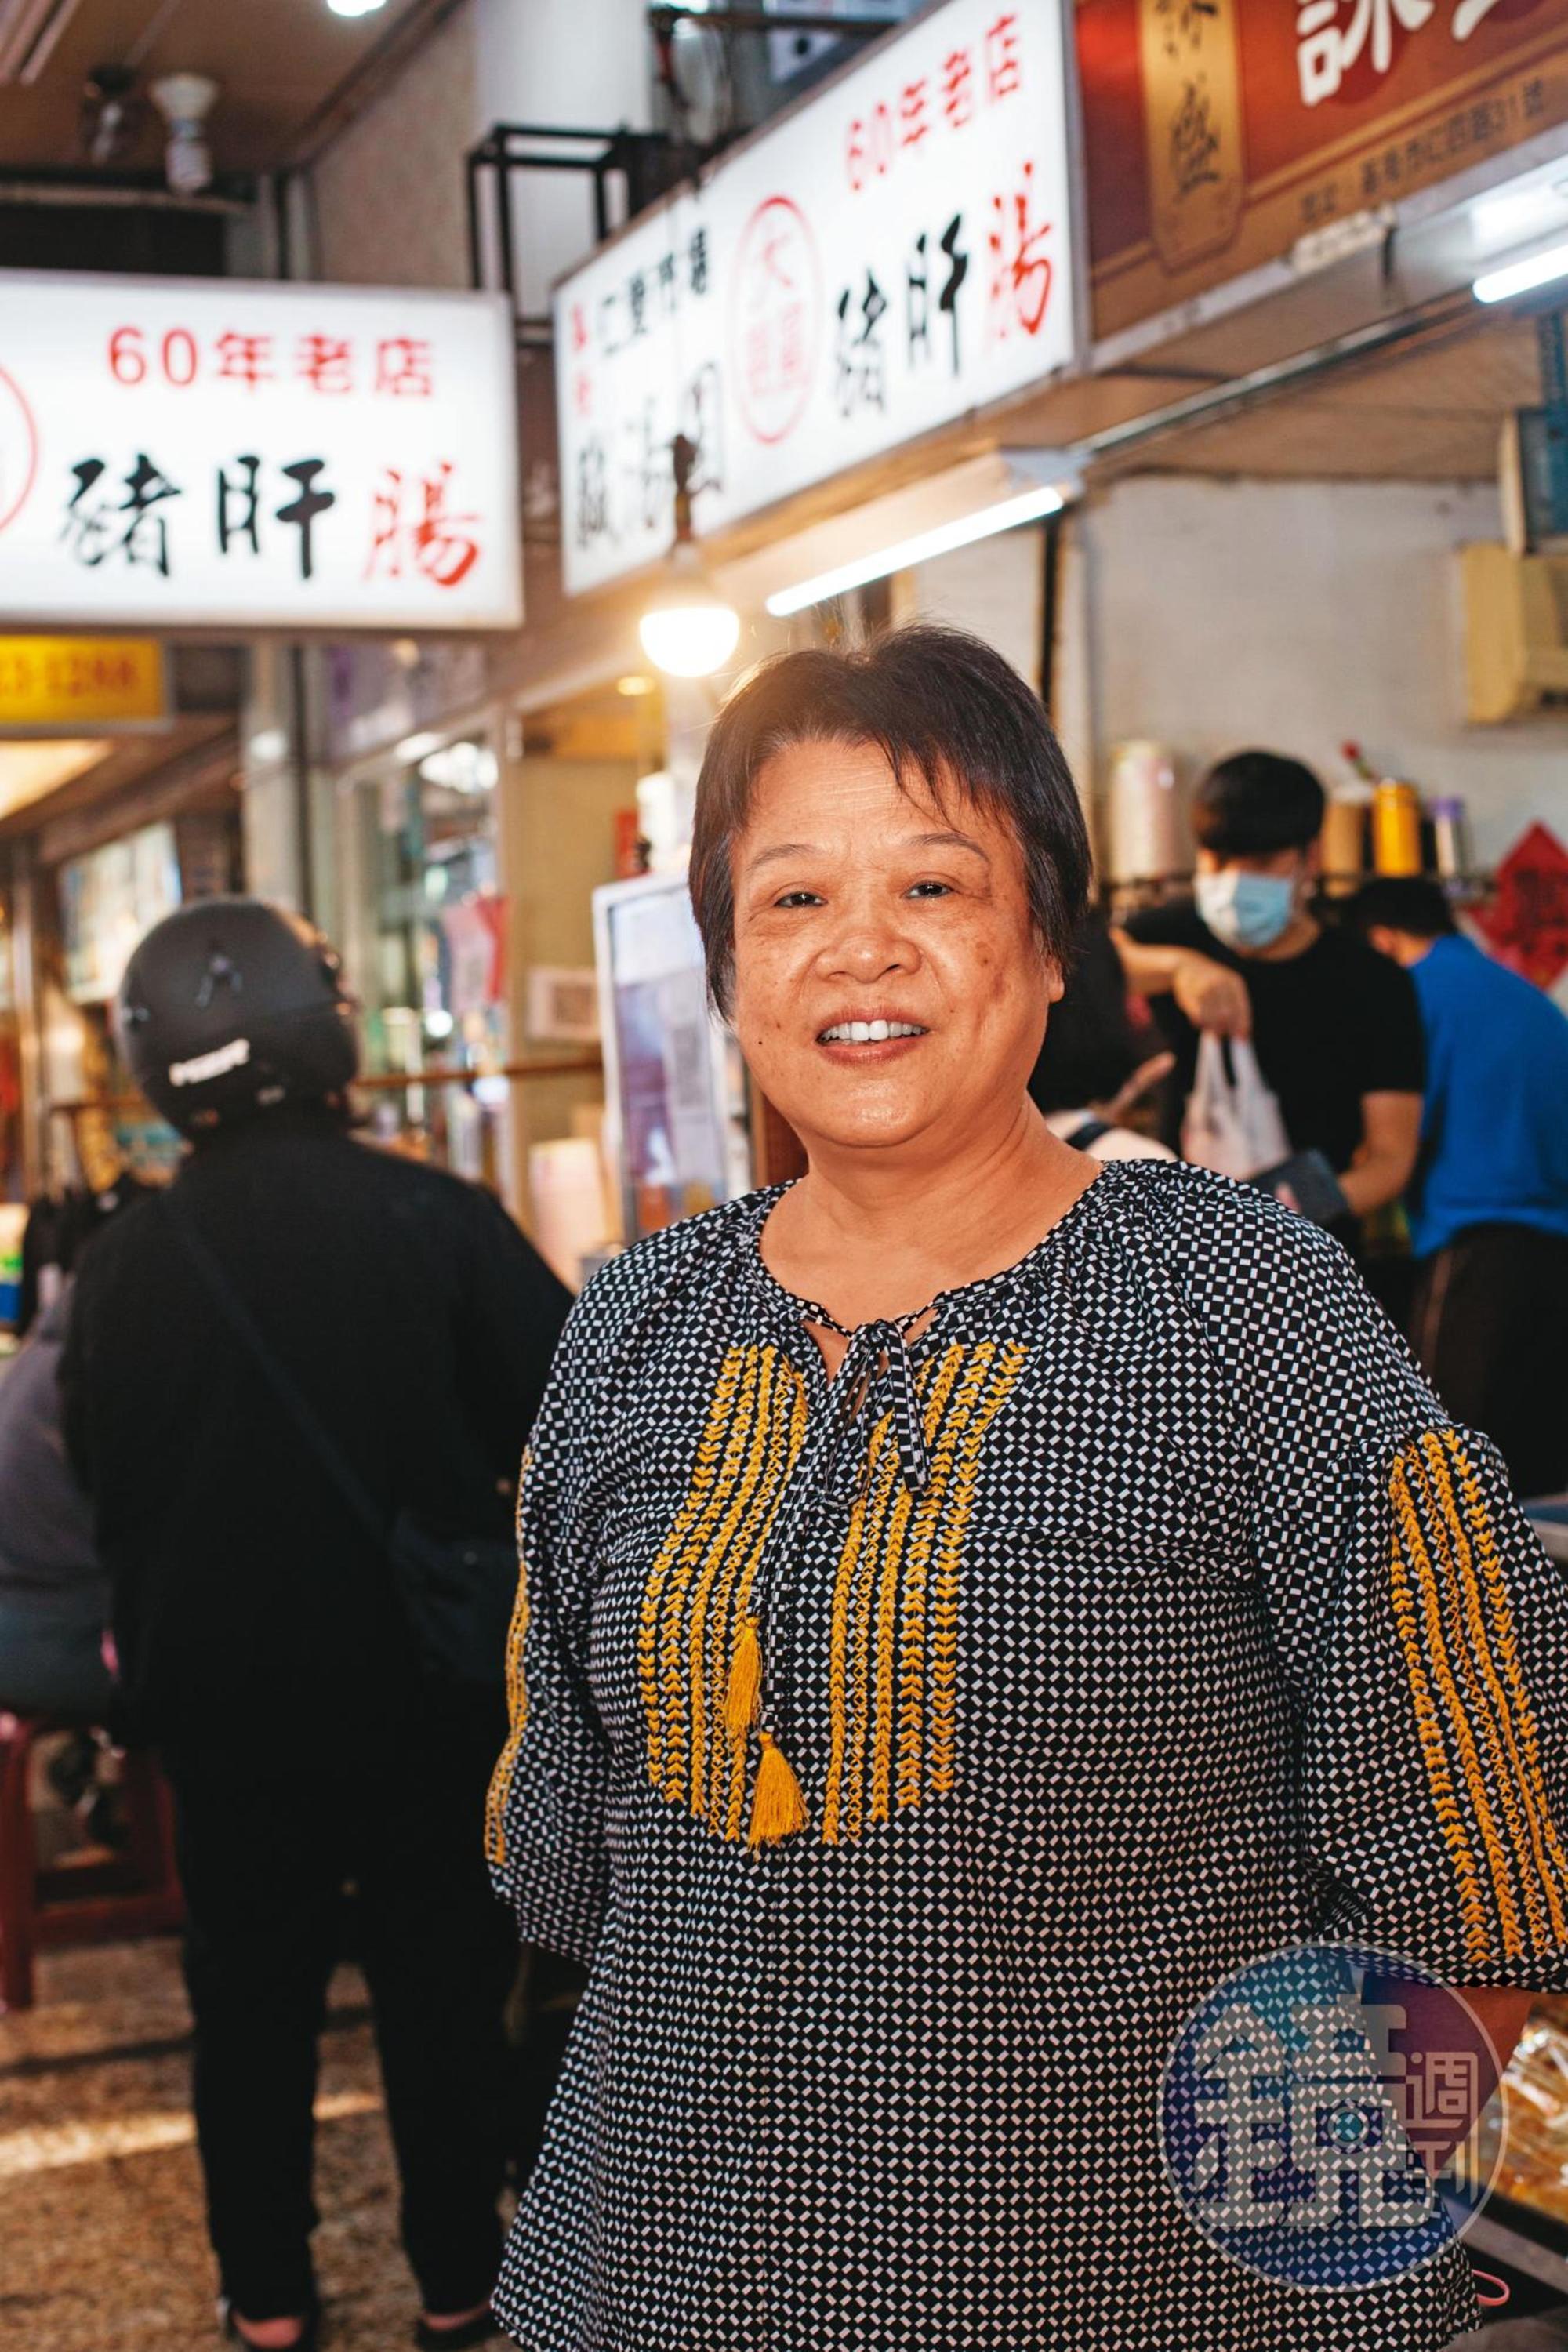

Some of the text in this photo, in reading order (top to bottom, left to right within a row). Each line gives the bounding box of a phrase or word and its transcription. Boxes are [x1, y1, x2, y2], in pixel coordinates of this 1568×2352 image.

[845, 12, 1022, 193] 60年老店
[107, 325, 434, 398] 60年老店
